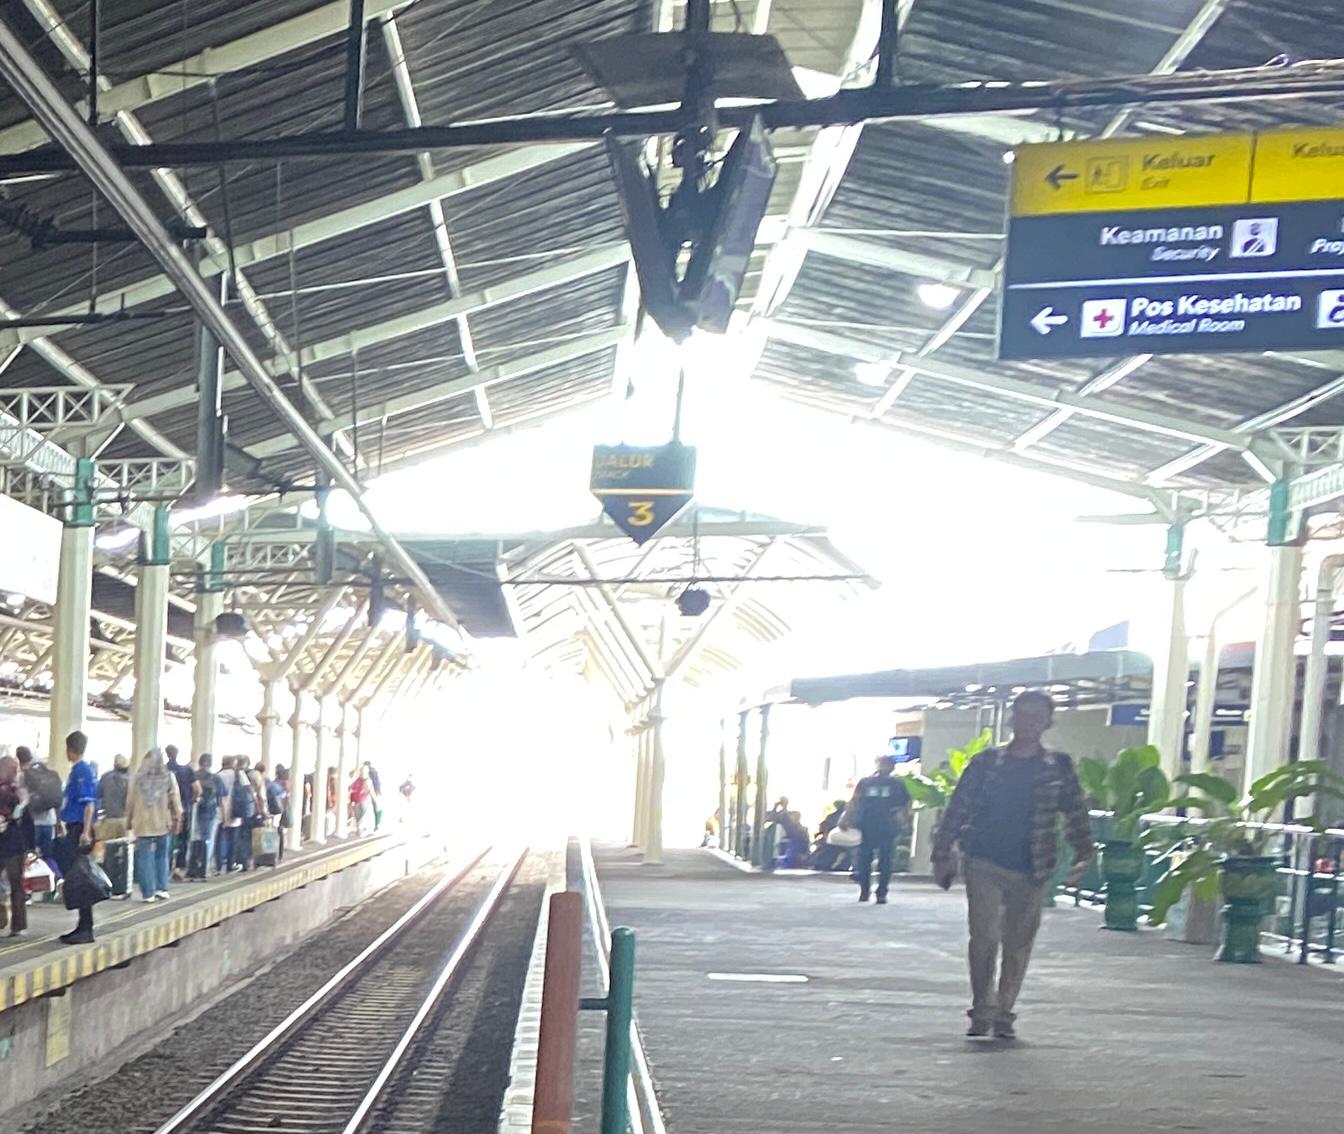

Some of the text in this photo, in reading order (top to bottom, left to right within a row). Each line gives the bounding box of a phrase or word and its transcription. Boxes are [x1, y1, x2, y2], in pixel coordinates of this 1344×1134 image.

[1141, 152, 1216, 172] Keluar
[1100, 224, 1223, 246] Keamanan
[1152, 244, 1220, 262] Security
[1131, 293, 1302, 317] Pos Kesehatan
[1127, 317, 1246, 336] Medical Room
[628, 501, 655, 526] 3
